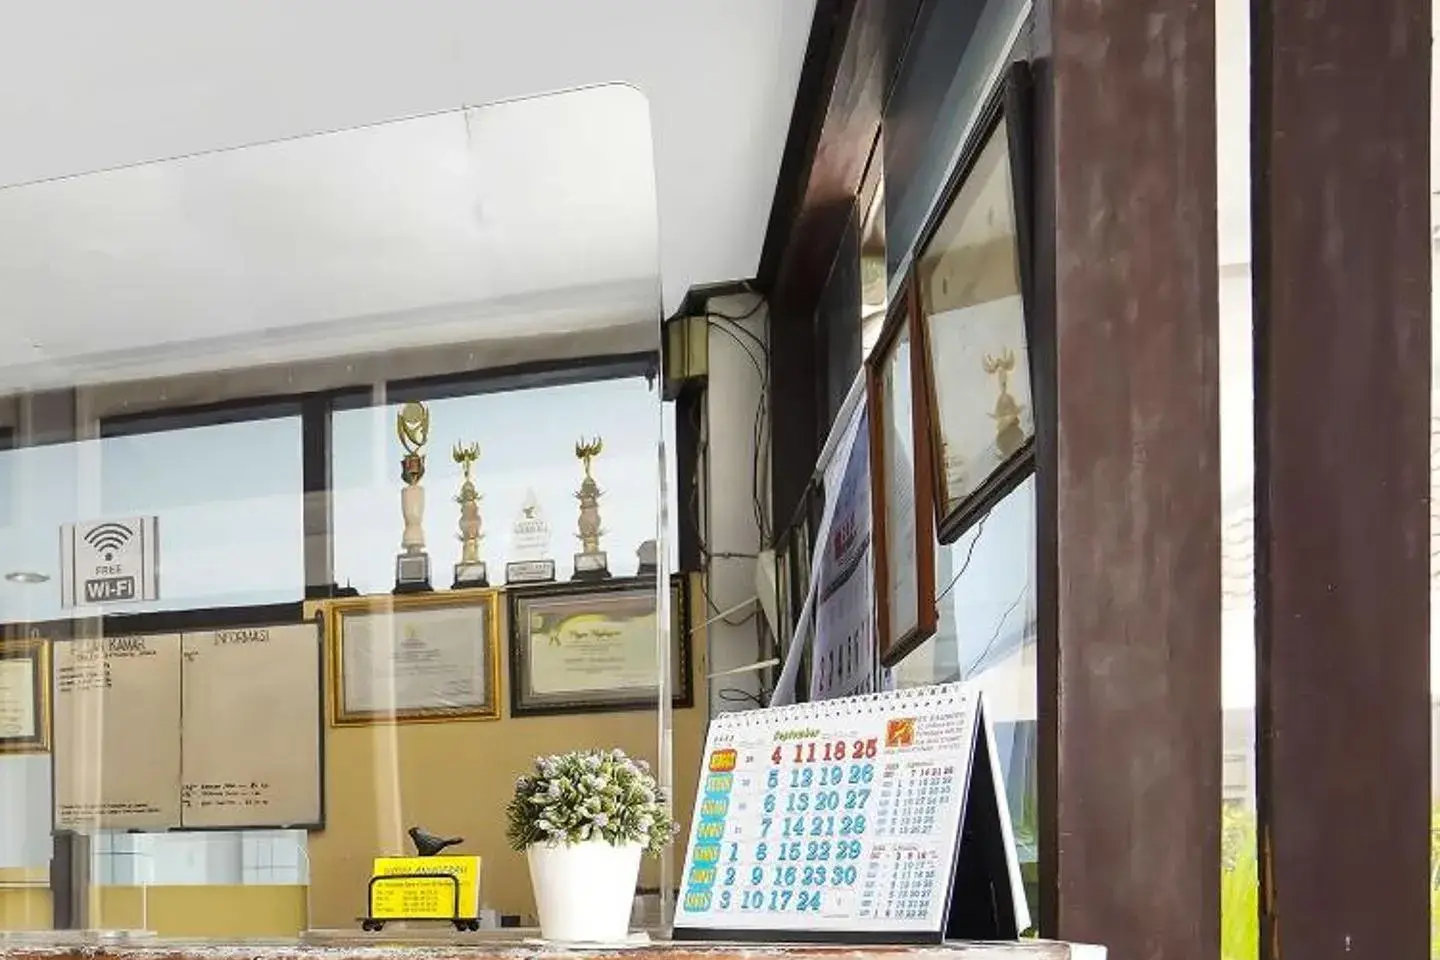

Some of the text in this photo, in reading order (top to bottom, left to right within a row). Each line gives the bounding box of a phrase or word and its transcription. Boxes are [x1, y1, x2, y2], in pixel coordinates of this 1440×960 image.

[95, 564, 122, 575] FREE
[771, 746, 782, 764] 4
[793, 743, 816, 763] 11
[823, 741, 846, 761] 18
[852, 737, 878, 759] 25
[768, 763, 874, 788] 5 12 19 26
[764, 788, 871, 813] 6 13 20 27
[761, 818, 773, 837] 7
[782, 816, 805, 837] 14
[810, 815, 834, 836] 21
[839, 814, 866, 834] 28
[728, 842, 738, 861] 1
[756, 842, 768, 861] 8
[778, 841, 802, 861] 15
[806, 841, 832, 861] 22
[835, 839, 862, 861] 29
[724, 867, 736, 886] 2
[751, 866, 763, 885] 9
[773, 866, 798, 885] 16
[801, 866, 827, 886] 23
[831, 865, 857, 886] 30
[720, 891, 732, 909] 3
[740, 891, 764, 909] 10
[768, 891, 794, 911] 17
[796, 890, 822, 911] 24
